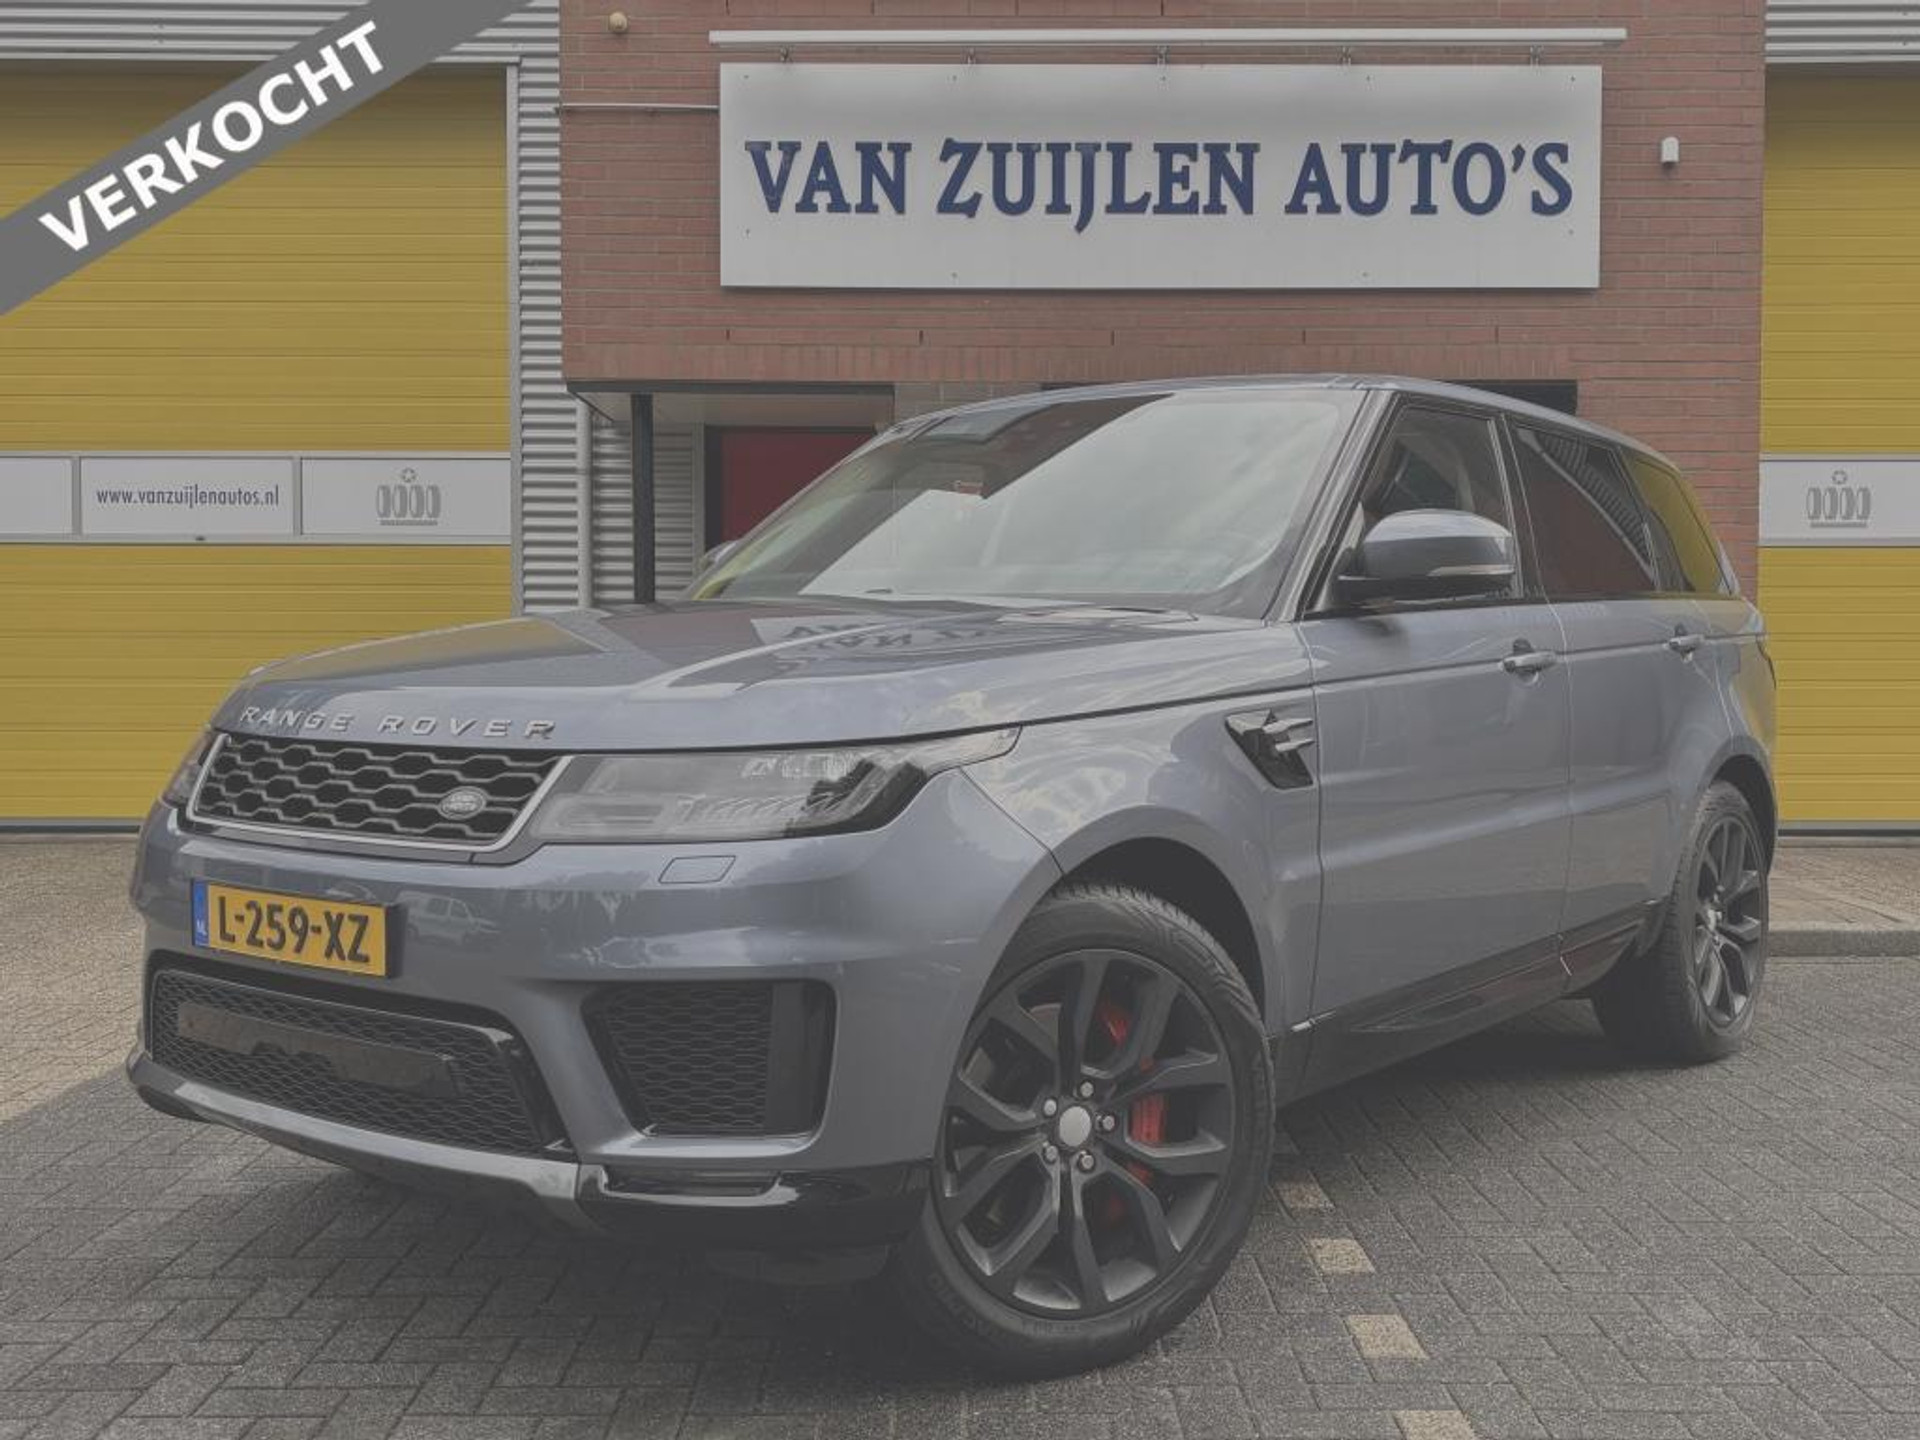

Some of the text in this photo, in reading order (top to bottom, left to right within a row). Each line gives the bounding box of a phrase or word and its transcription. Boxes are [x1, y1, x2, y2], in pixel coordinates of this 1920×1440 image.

[744, 137, 1574, 234] VAN ZUIJLEN AUTO'S
[96, 483, 279, 510] www.vanzuijlenautos.nl
[238, 705, 556, 741] RANGE ROVER
[217, 896, 371, 963] L-259-XZ
